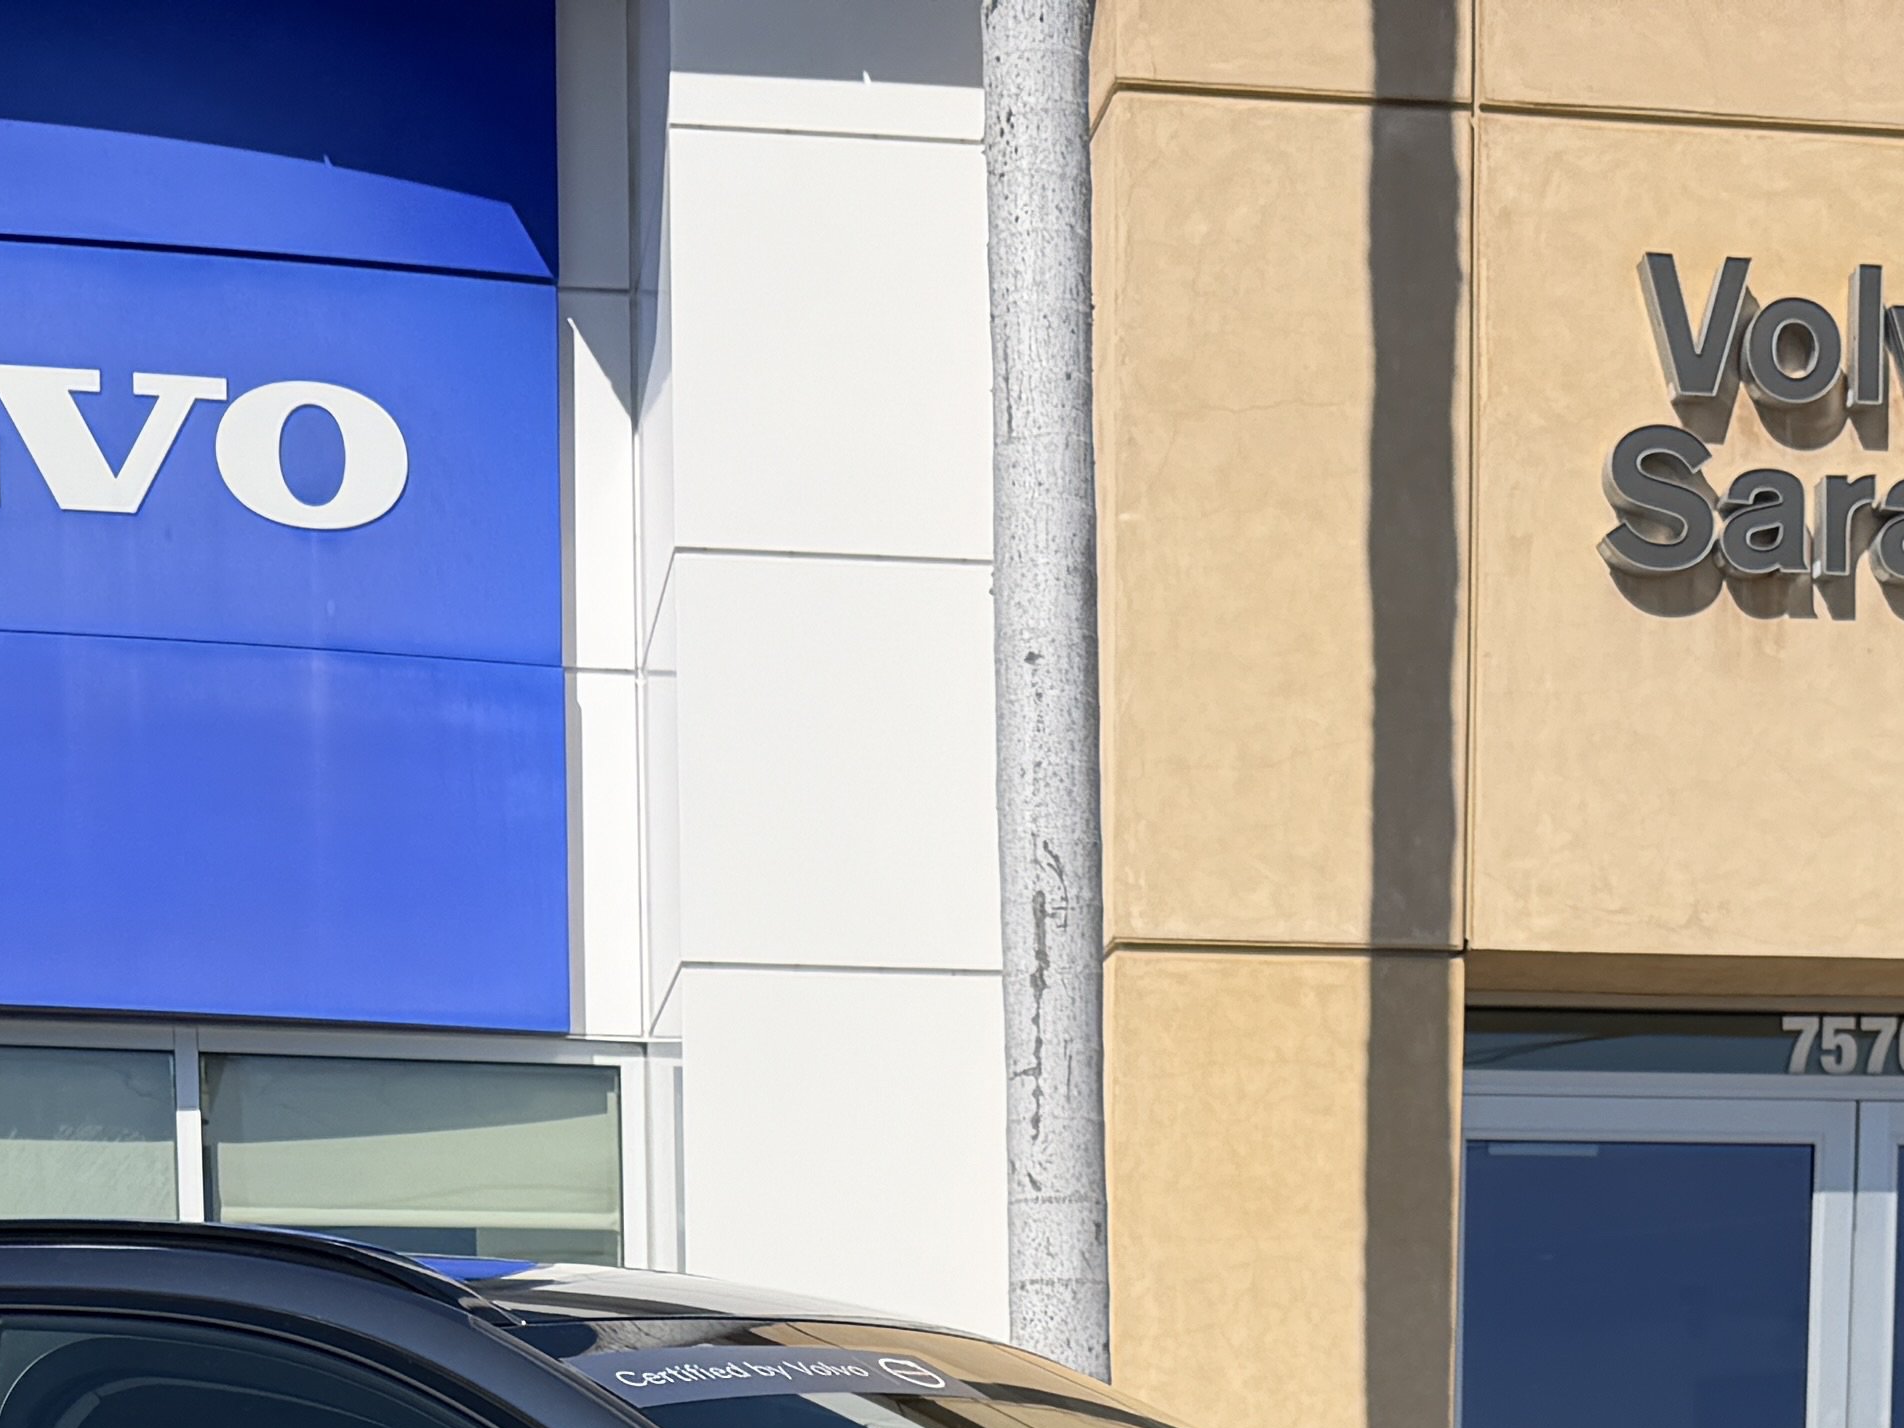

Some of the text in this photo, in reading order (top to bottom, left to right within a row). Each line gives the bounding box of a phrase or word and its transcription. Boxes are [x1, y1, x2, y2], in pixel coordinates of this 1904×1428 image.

[615, 1361, 869, 1387] Certified by Volvo
